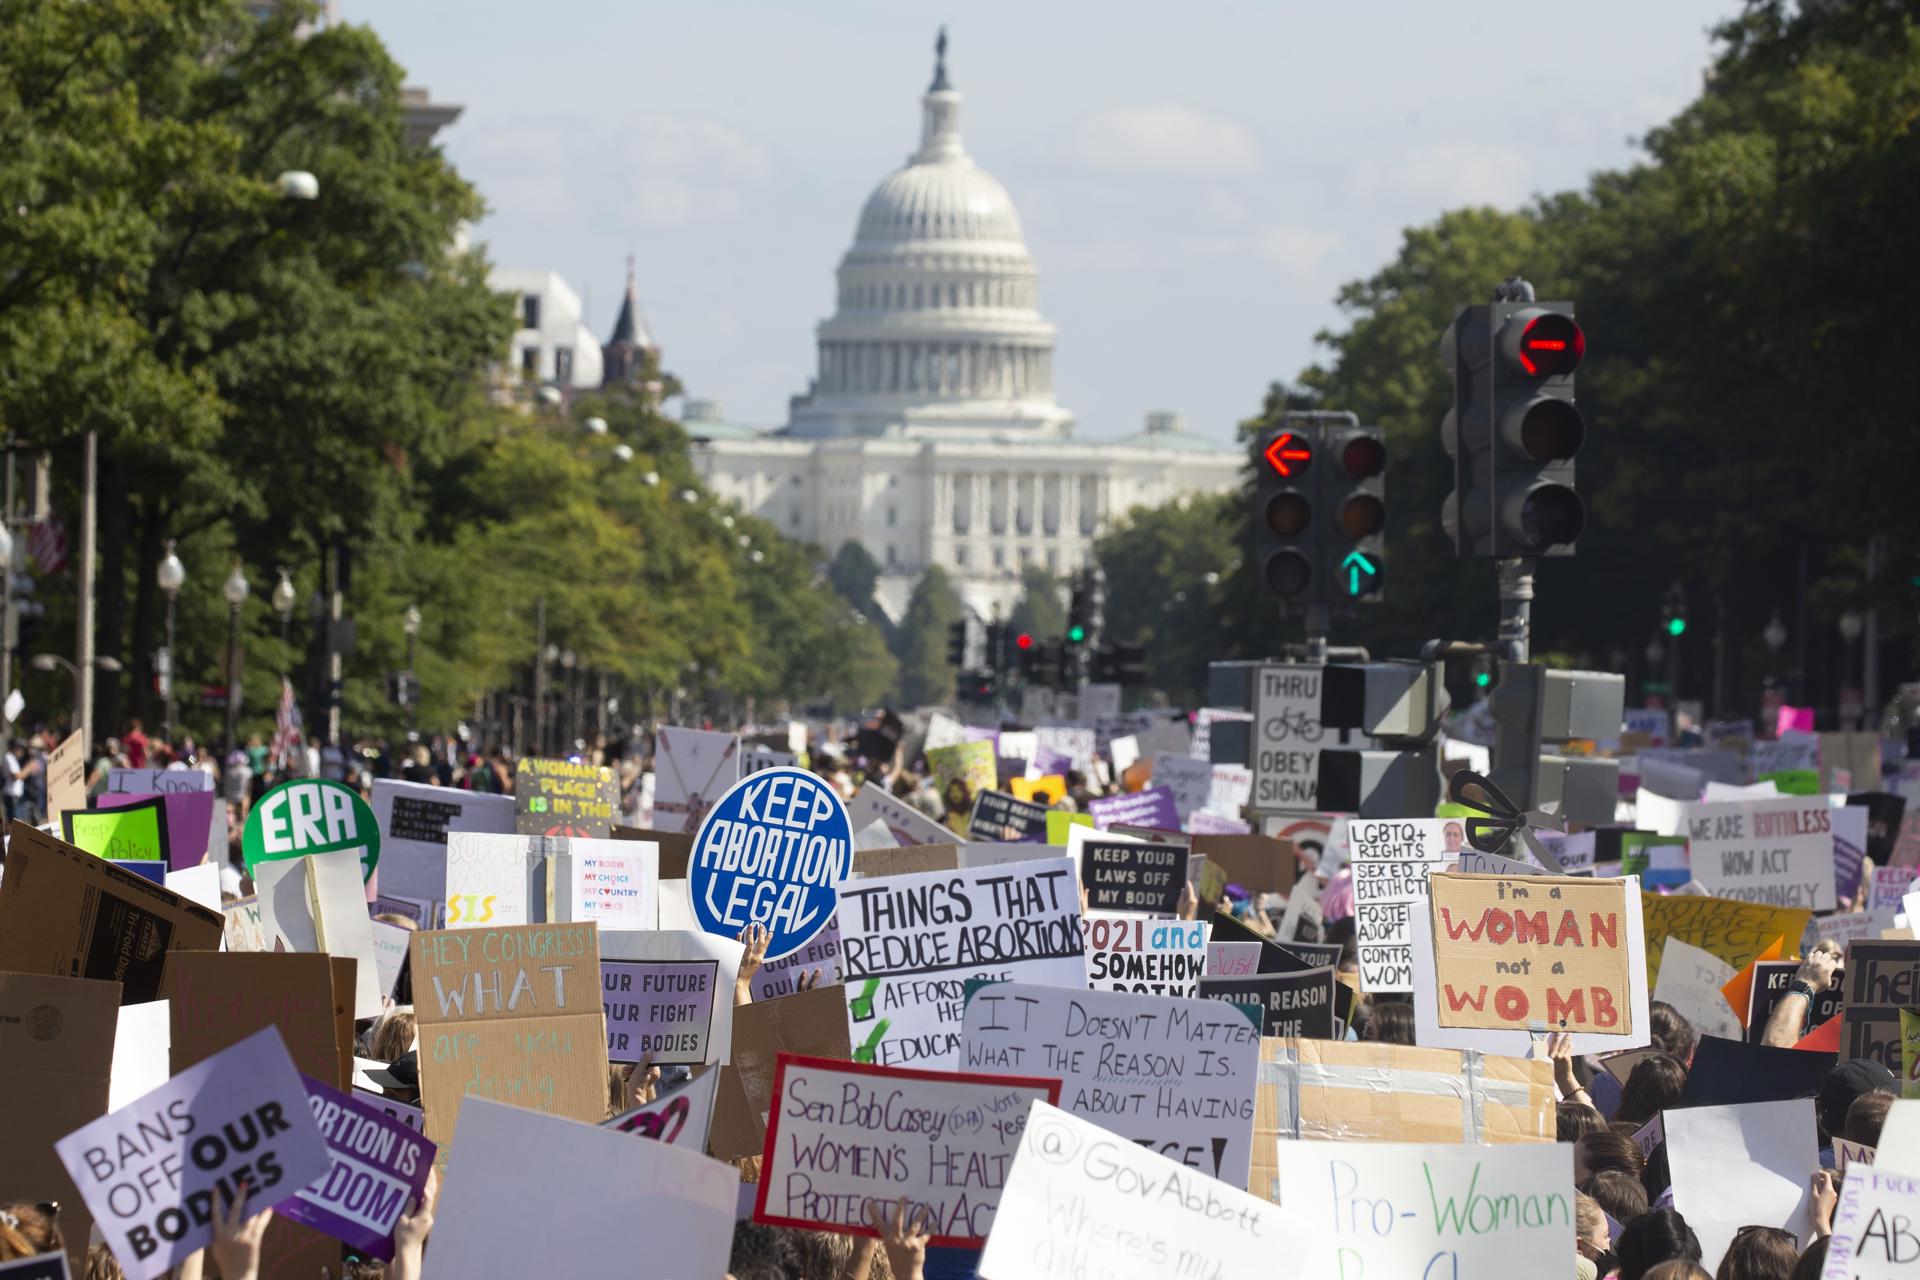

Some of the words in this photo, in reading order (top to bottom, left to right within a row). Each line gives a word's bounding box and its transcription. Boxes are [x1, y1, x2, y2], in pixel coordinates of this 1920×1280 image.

[1263, 674, 1318, 698] THRU
[1259, 751, 1315, 773] OBEY
[552, 798, 573, 815] IN
[577, 802, 613, 818] THE
[738, 776, 834, 831] KEEP
[259, 783, 357, 853] ERA
[1688, 818, 1712, 841] WE
[1714, 814, 1745, 840] ARE
[1752, 809, 1831, 838] RUTHLESS
[1352, 823, 1427, 844] LGBTQ+
[110, 839, 153, 860] Policy
[700, 818, 846, 889] ABORTION
[1093, 848, 1131, 863] KEEP
[1136, 851, 1176, 866] YOUR
[1359, 843, 1425, 858] RIGHTS
[584, 859, 597, 867] MY
[1358, 864, 1385, 878] SEX
[1721, 851, 1755, 876] NOW
[1761, 849, 1792, 875] ACT
[584, 873, 597, 881] MY
[598, 874, 630, 885] CHOICE
[1095, 868, 1138, 884] LAWS
[1142, 871, 1171, 886] OFF
[1358, 879, 1403, 900] BIRTH
[584, 900, 597, 909] MY
[705, 872, 820, 935] LEGAL
[840, 878, 972, 932] THINGS
[975, 870, 1068, 919] THAT
[1098, 889, 1121, 904] MY
[1125, 891, 1166, 906] BODY
[1549, 886, 1562, 900] a
[1359, 905, 1411, 923] FOSTE
[1668, 913, 1780, 931] CHOICE
[121, 911, 140, 957] Tri-Fold
[1151, 922, 1204, 950] and
[1358, 923, 1405, 941] ADOPT
[1440, 906, 1619, 948] WOMAN
[420, 934, 472, 967] HEY
[483, 928, 595, 964] CONGRESS!
[843, 931, 950, 979] REDUCE
[956, 913, 1085, 965] ABORTIONS
[1089, 952, 1206, 981] SOMEHOW
[1496, 958, 1531, 975] not
[1551, 960, 1565, 975] a
[431, 966, 575, 1020] WHAT
[643, 974, 708, 993] FUTURE
[1270, 985, 1328, 1011] REASON
[1444, 984, 1618, 1028] WOMB
[650, 1003, 697, 1023] FIGHT
[979, 996, 1040, 1033] IT
[641, 1033, 699, 1052] BODIES
[787, 1078, 834, 1125] Sen
[840, 1081, 876, 1130] Bob
[884, 1090, 947, 1142] Casey
[1072, 1088, 1147, 1113] ABOUT
[83, 1098, 197, 1183] BANS
[107, 1153, 184, 1219] OFF
[190, 1099, 292, 1172] OUR
[393, 1137, 422, 1179] IS
[791, 1132, 909, 1182] WOMEN'S
[125, 1150, 284, 1262] BODIES
